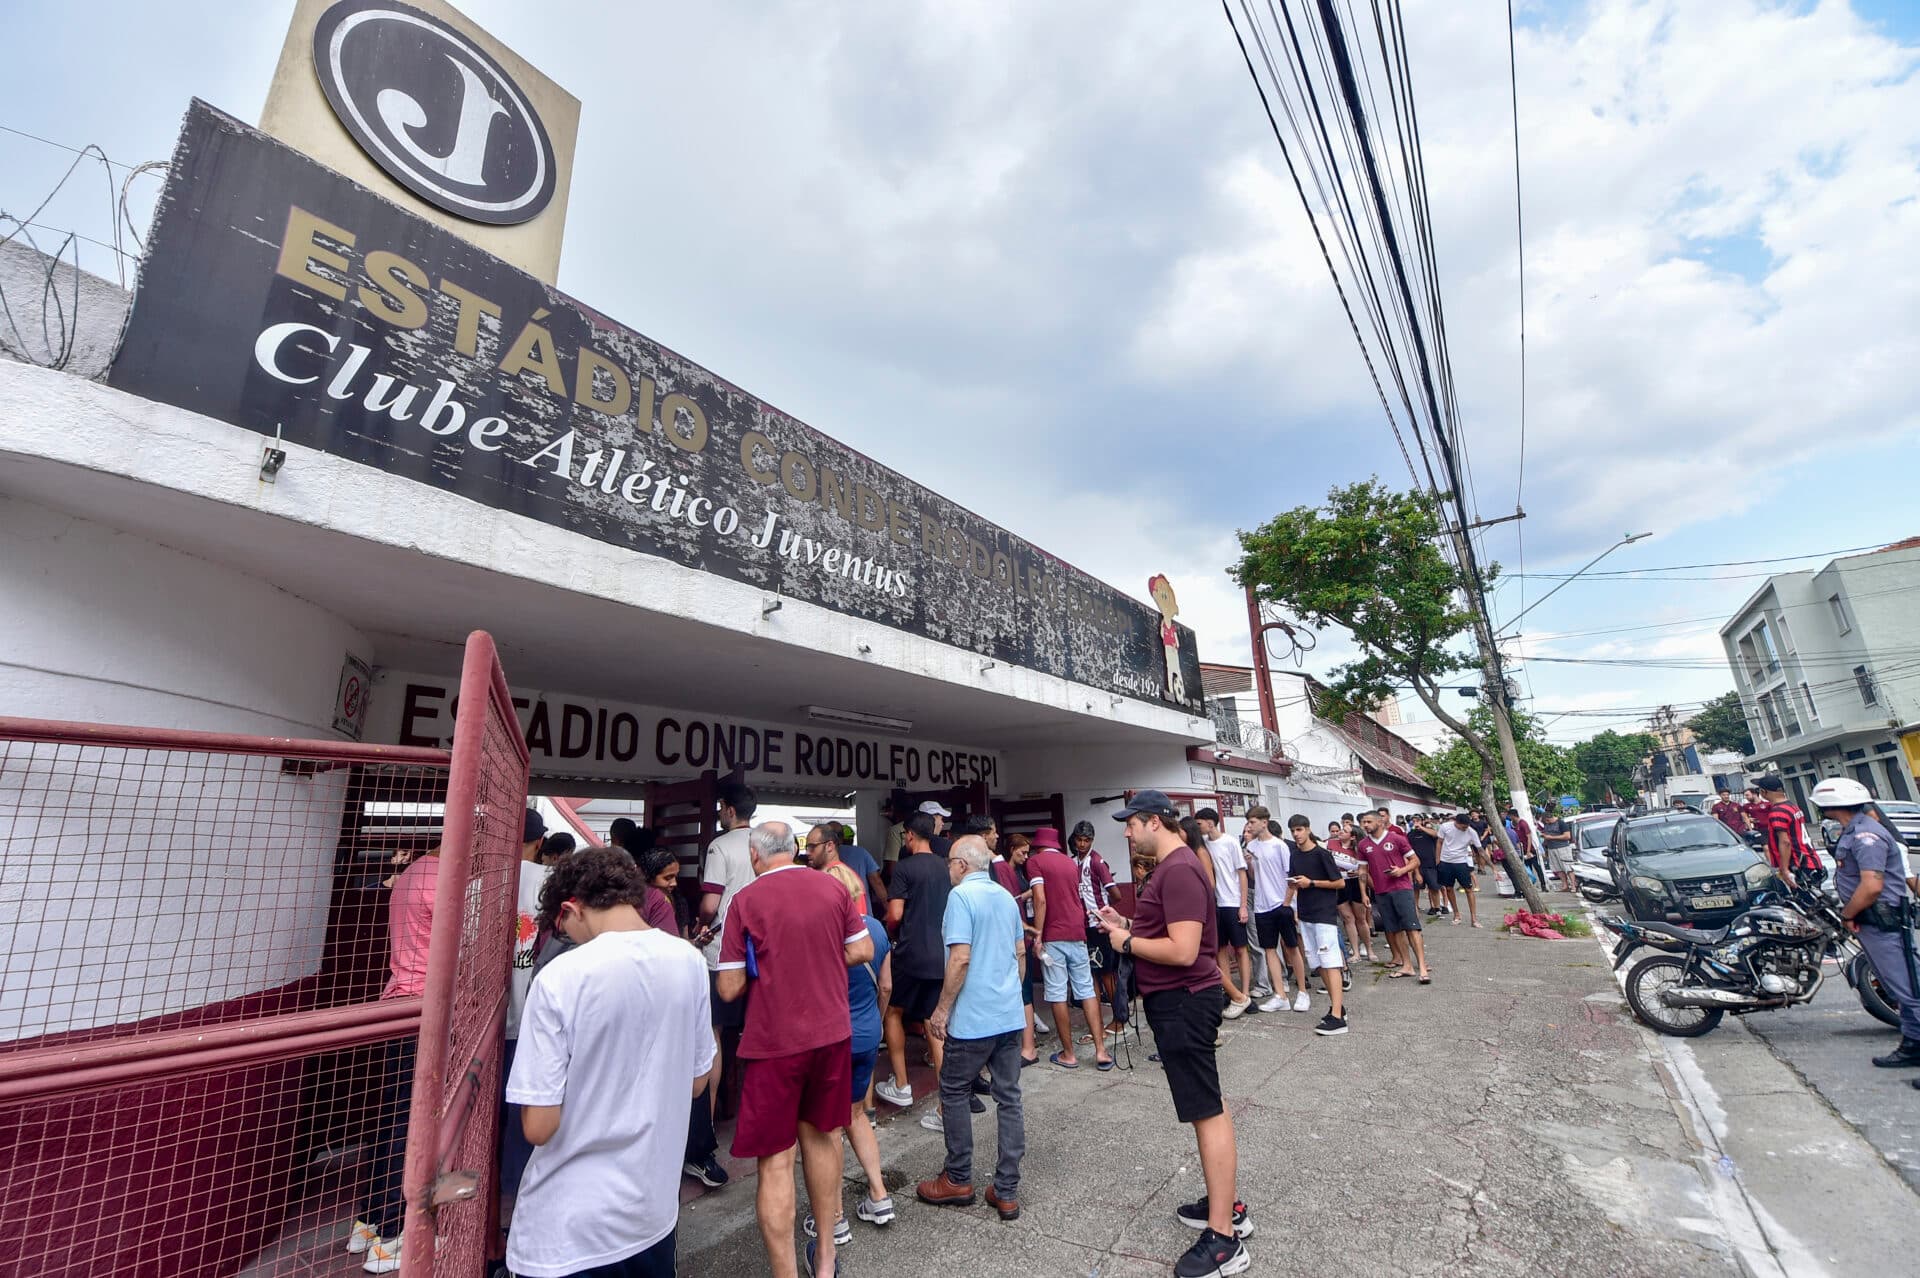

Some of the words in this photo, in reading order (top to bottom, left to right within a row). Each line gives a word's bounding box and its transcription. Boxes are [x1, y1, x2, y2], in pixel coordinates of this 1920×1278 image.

[254, 321, 509, 452] Clube
[520, 428, 739, 536] Atlético
[751, 509, 907, 598] Juventus
[275, 204, 709, 453] ESTÁDIO
[740, 431, 912, 547] CONDE
[920, 511, 1060, 610] RODOLFO
[399, 683, 639, 763] EADIO
[655, 716, 784, 774] CONDE
[795, 732, 920, 783] RODOLFO
[927, 749, 998, 788] CRESPI
[1112, 668, 1138, 692] desde
[1140, 677, 1160, 699] 1924
[1221, 775, 1255, 788] BILHETERIA
